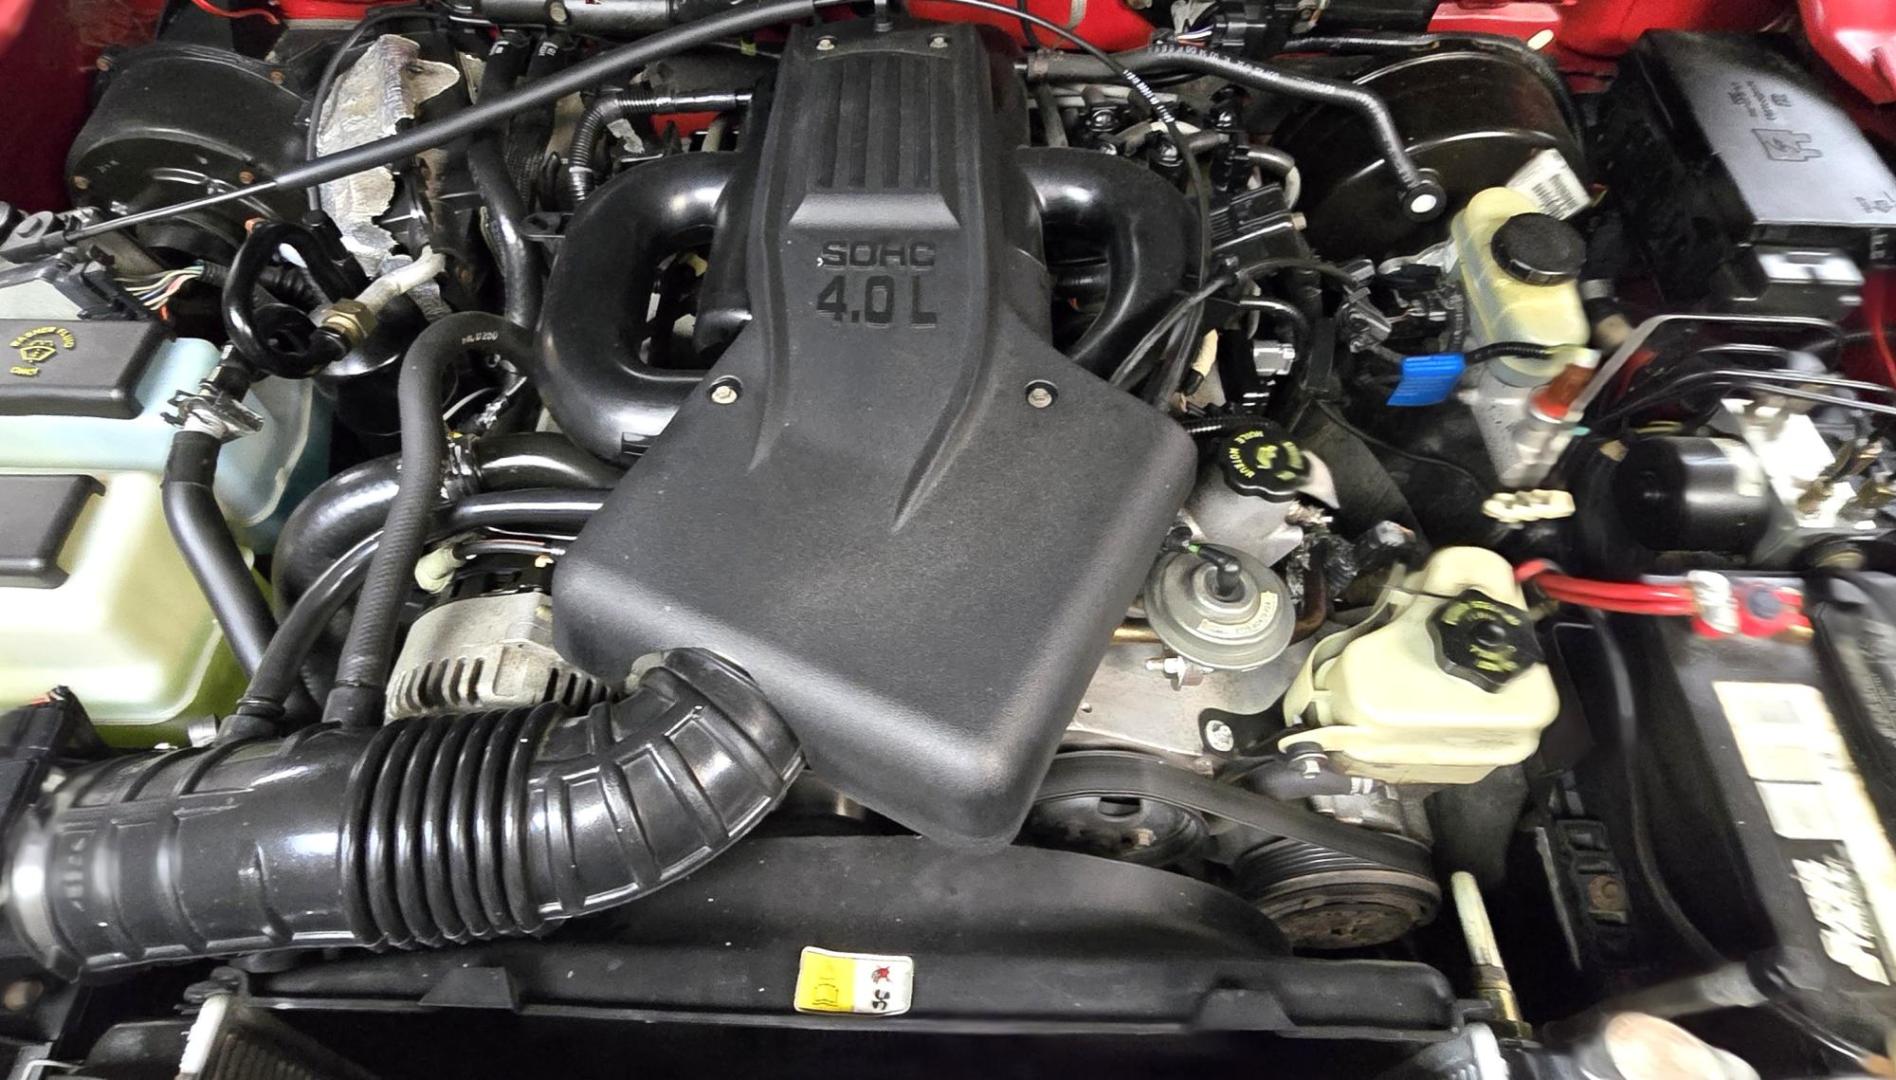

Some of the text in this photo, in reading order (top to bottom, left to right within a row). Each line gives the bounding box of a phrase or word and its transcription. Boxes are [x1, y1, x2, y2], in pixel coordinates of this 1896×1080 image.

[822, 240, 936, 268] SOHC
[816, 275, 938, 325] 4.0 L
